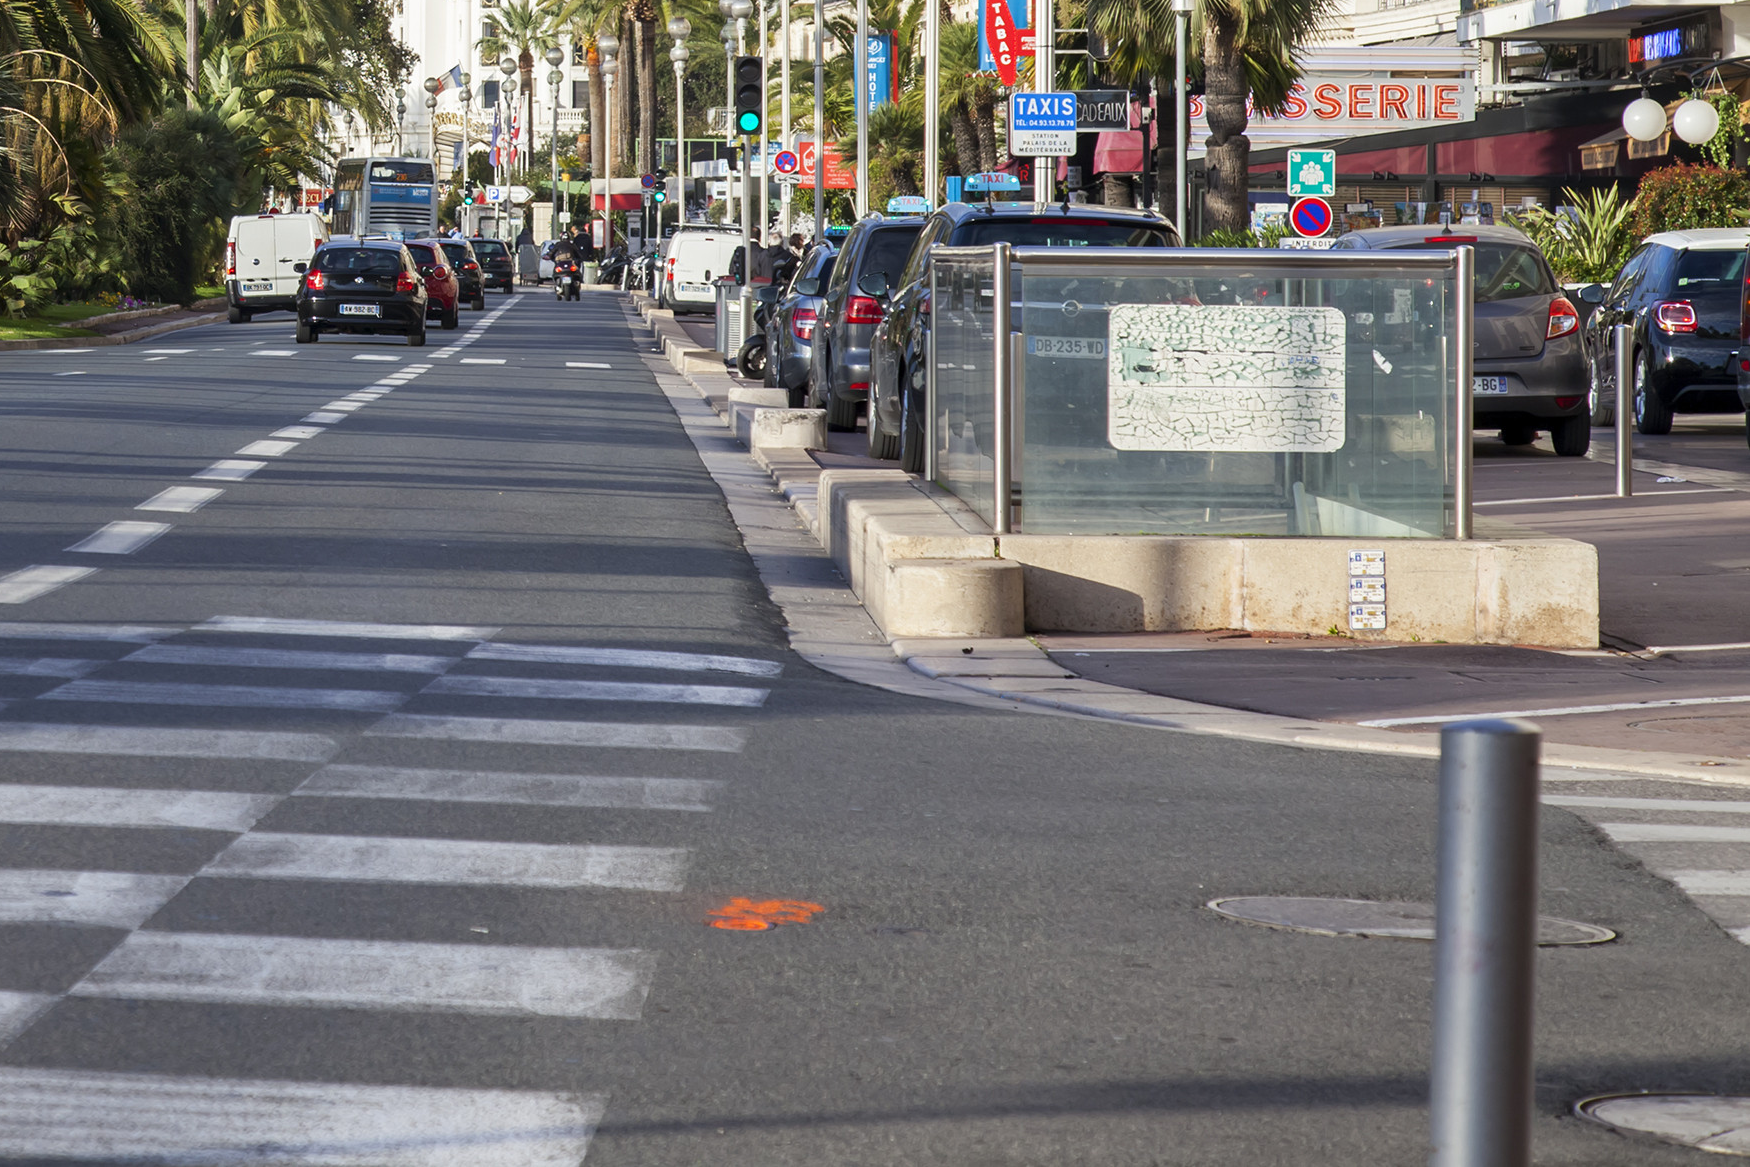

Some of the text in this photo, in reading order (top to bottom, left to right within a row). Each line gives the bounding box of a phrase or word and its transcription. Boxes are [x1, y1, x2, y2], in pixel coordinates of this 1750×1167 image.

[991, 2, 1011, 65] TABAC
[868, 72, 877, 115] HOTE
[1016, 98, 1073, 115] TAXIS
[980, 174, 1004, 183] TAXI
[1035, 338, 1104, 355] DB-235-WD
